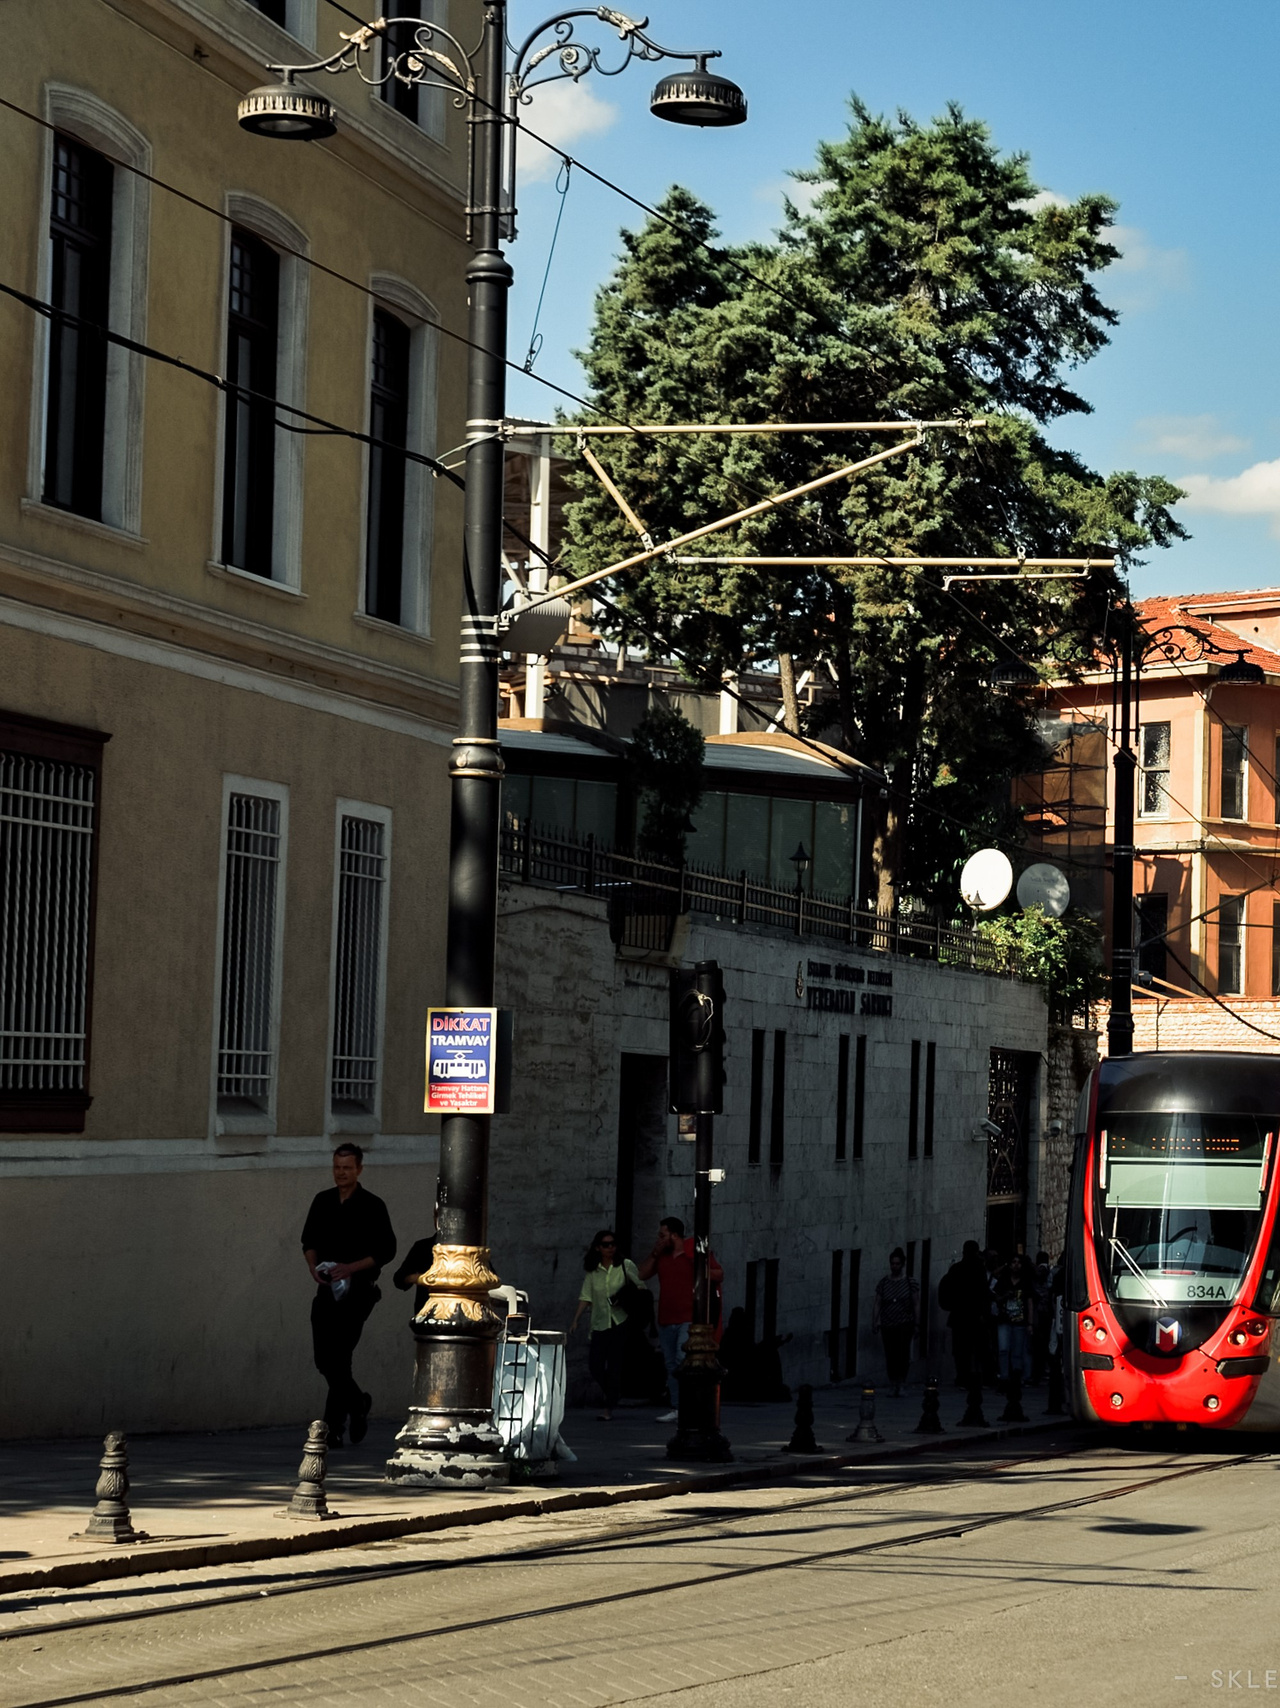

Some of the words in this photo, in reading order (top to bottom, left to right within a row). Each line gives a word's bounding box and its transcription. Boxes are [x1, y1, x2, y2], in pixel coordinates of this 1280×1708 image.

[433, 1016, 490, 1031] DİKKAT
[431, 1035, 490, 1047] TRAMVAY
[430, 1084, 460, 1093] Tramvay
[460, 1084, 488, 1092] Hattına
[457, 1092, 487, 1100] Tehlikeli
[449, 1099, 478, 1107] Yasaktır
[1187, 1285, 1227, 1299] 834A
